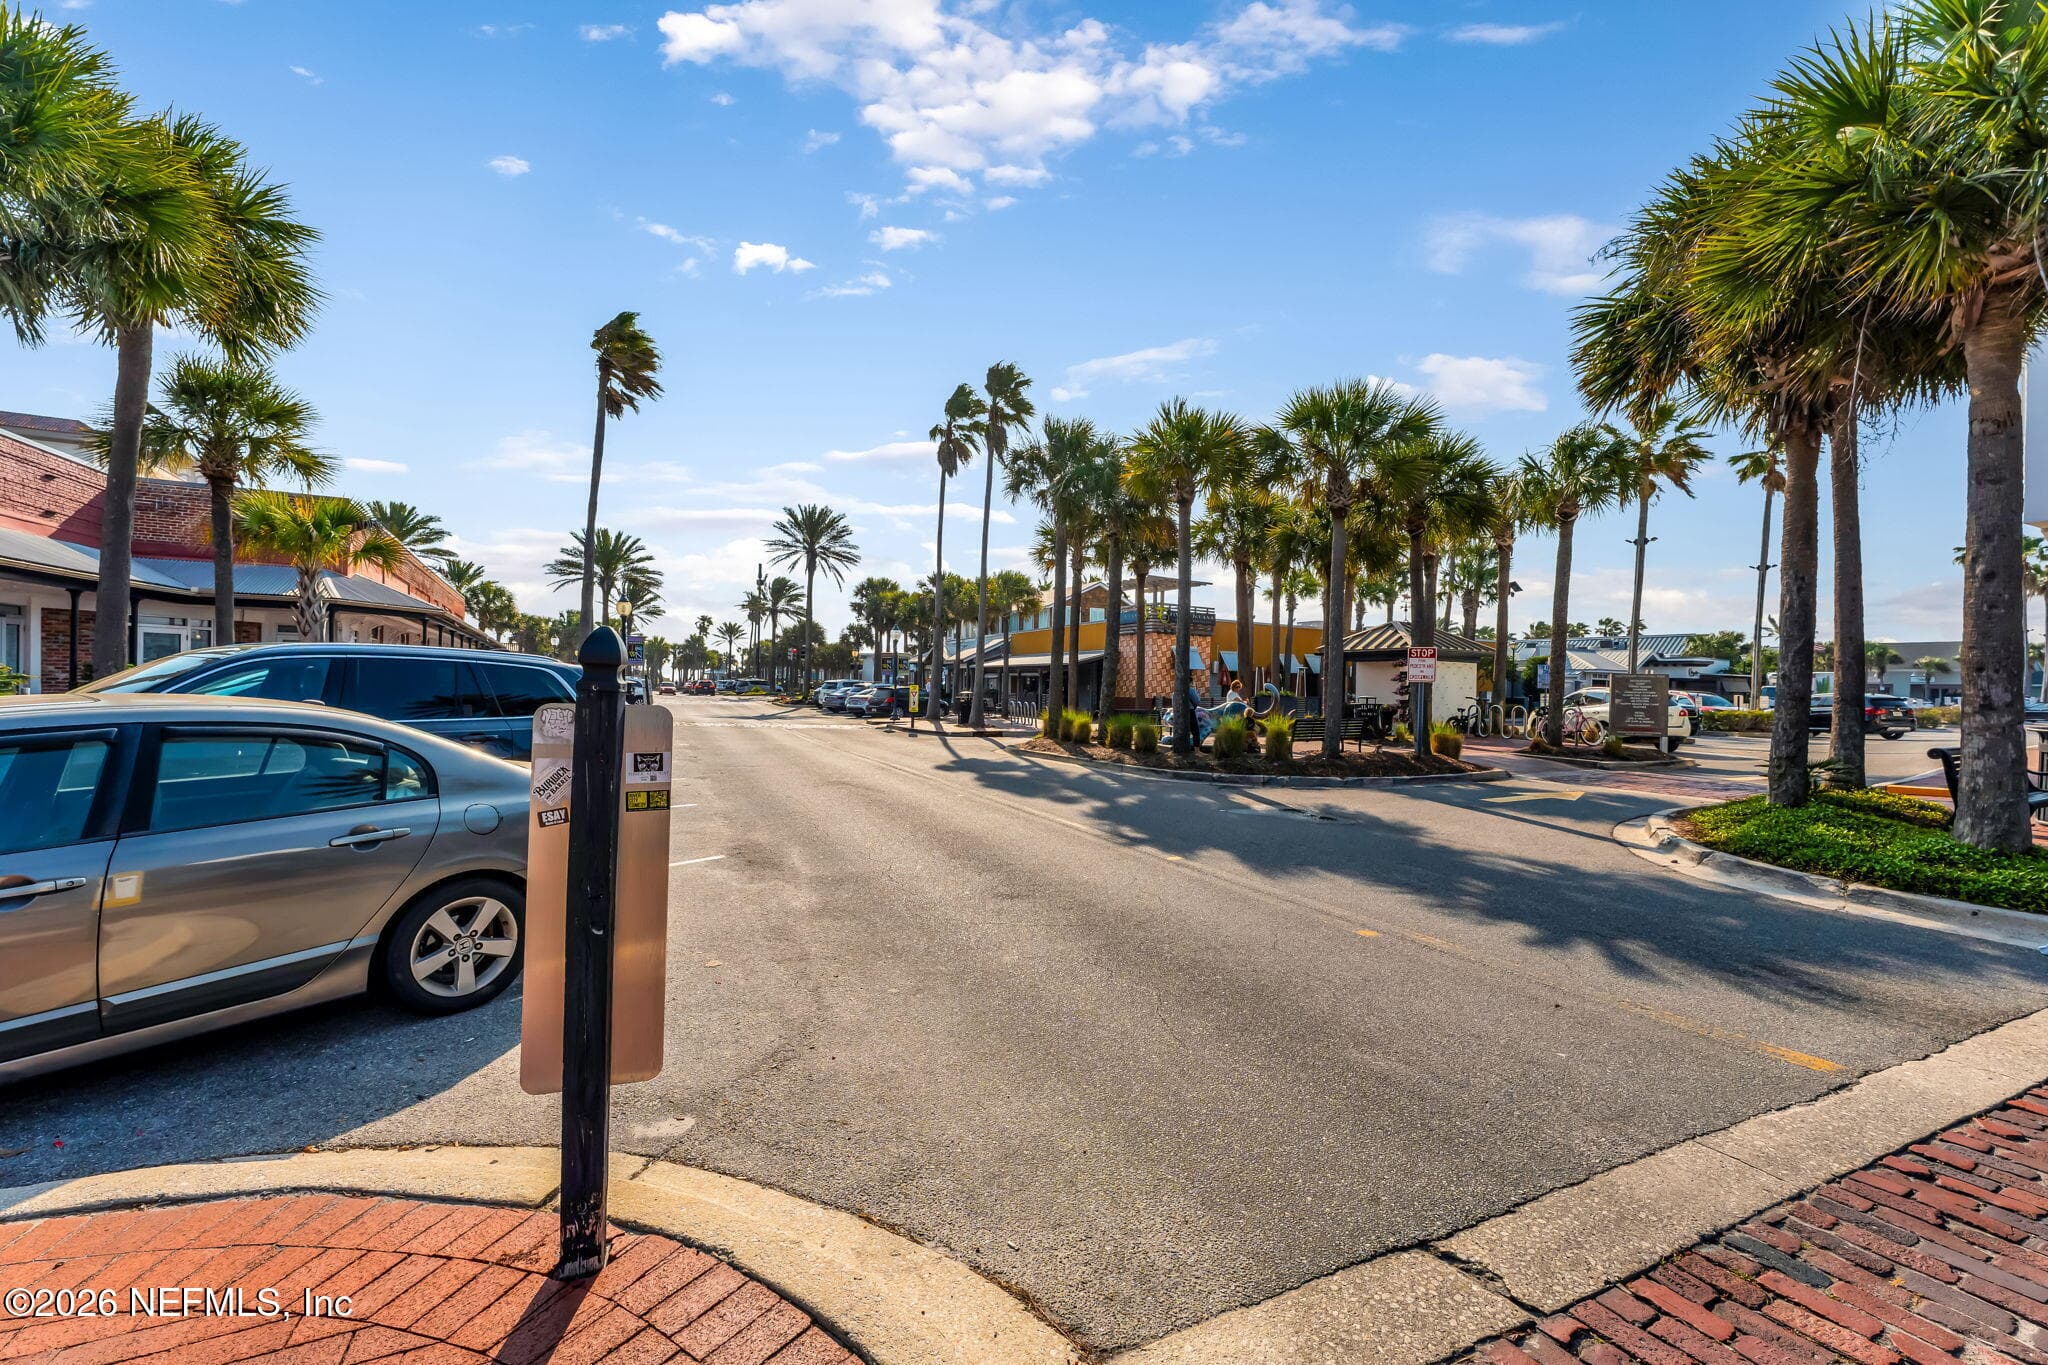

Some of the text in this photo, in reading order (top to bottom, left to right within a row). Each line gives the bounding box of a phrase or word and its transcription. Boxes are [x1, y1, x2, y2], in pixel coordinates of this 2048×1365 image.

[1411, 649, 1434, 657] STOP
[550, 774, 572, 795] BARREL
[541, 809, 566, 823] ESAY
